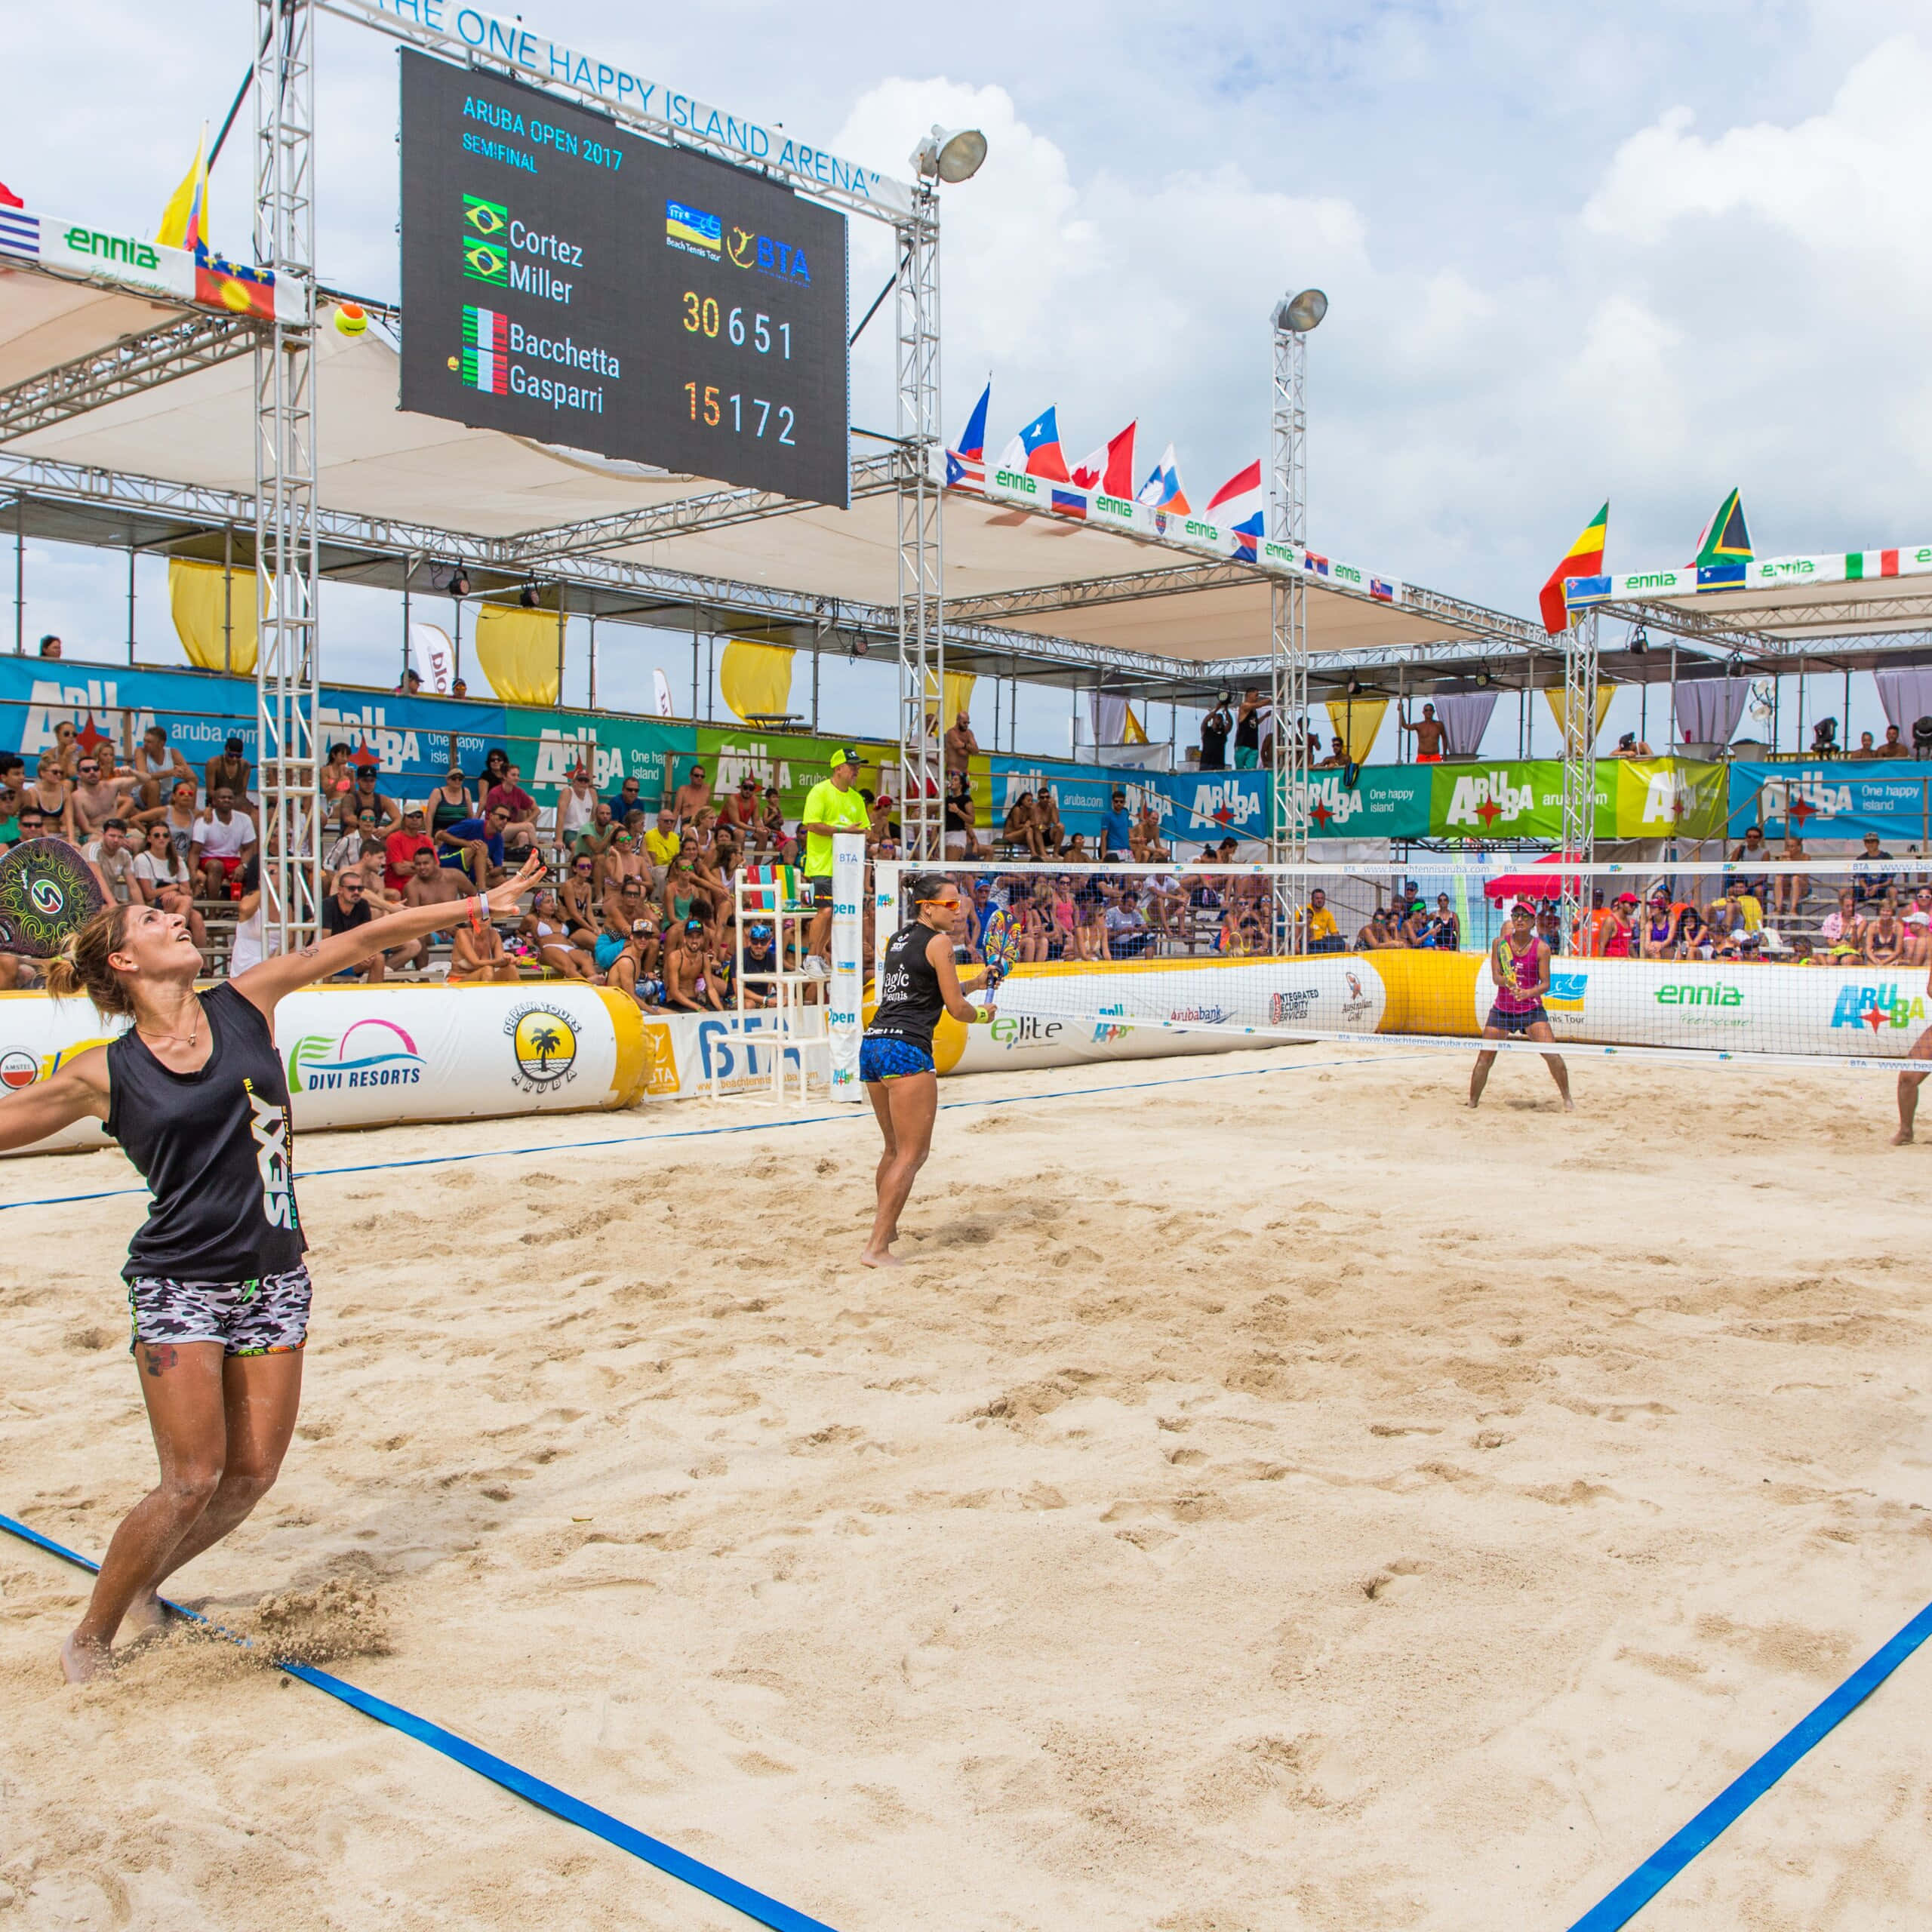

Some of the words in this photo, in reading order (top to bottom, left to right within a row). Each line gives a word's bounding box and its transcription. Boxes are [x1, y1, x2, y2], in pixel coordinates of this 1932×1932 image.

[458, 9, 537, 68] ONE
[550, 44, 655, 112] HAPPY
[666, 91, 768, 157] ISLAND
[463, 97, 525, 136] ARUBA
[531, 121, 578, 155] OPEN
[583, 139, 623, 171] 2017
[463, 133, 538, 173] SEMIFINAL
[64, 228, 161, 269] ennia
[510, 220, 583, 268] Cortez
[666, 237, 685, 251] Beach
[685, 243, 706, 257] Tennis
[706, 250, 721, 262] Tour
[758, 235, 811, 281] BTA
[510, 260, 573, 303] Miller
[683, 291, 718, 337] 30
[728, 307, 745, 346] 6
[755, 313, 771, 353] 5
[780, 322, 791, 360] 1
[511, 324, 620, 378] Bacchetta
[511, 365, 603, 414] Gasparri
[685, 381, 720, 426] 15
[730, 394, 741, 432] 1
[754, 399, 771, 438] 7
[779, 406, 795, 446] 2
[996, 471, 1036, 493] ennia
[1097, 496, 1133, 517] ennia
[1185, 520, 1217, 540] ennia
[1266, 543, 1294, 561] ennia
[1335, 565, 1361, 583] ennia
[1626, 574, 1677, 589] ennia
[171, 722, 260, 746] aruba.com
[428, 733, 449, 746] One
[457, 736, 485, 752] appy
[431, 749, 461, 765] islad
[532, 728, 624, 790] ARUBA
[632, 749, 649, 763] One
[652, 751, 680, 768] hay
[632, 766, 659, 780] island
[1002, 769, 1059, 818] ARUA
[1063, 794, 1103, 808] aruba.com
[1370, 789, 1386, 799] One
[1388, 789, 1414, 800] happy
[1446, 771, 1534, 825] ARUBA
[1755, 771, 1854, 824] ARUBA
[1861, 785, 1883, 797] One
[1886, 785, 1919, 798] happy
[1189, 780, 1260, 829] ARUBA
[1370, 802, 1394, 812] island
[1863, 799, 1894, 811] island
[839, 854, 857, 863] BTA
[1364, 864, 1489, 873] www.beachtennisaruba.com
[833, 903, 855, 916] pen
[884, 970, 909, 993] agic
[1654, 981, 1745, 1006] ennia
[509, 1001, 541, 1020] PALM
[541, 1001, 582, 1033] TOURS
[1342, 1000, 1373, 1014] Australian
[1348, 1011, 1363, 1022] Gold
[1831, 983, 1925, 1029] ARUBA
[503, 1018, 517, 1036] DE
[991, 1016, 1063, 1041] elite
[1564, 1014, 1586, 1023] Tour
[1358, 1035, 1483, 1049] www.beachtennisaruba.com
[309, 1072, 342, 1090] DIVI
[349, 1068, 420, 1088] RESORTS
[512, 1069, 577, 1094] ARUBA
[281, 1105, 291, 1167] TENNIS
[248, 1093, 293, 1231] SEXY
[288, 1172, 297, 1229] BEACH
